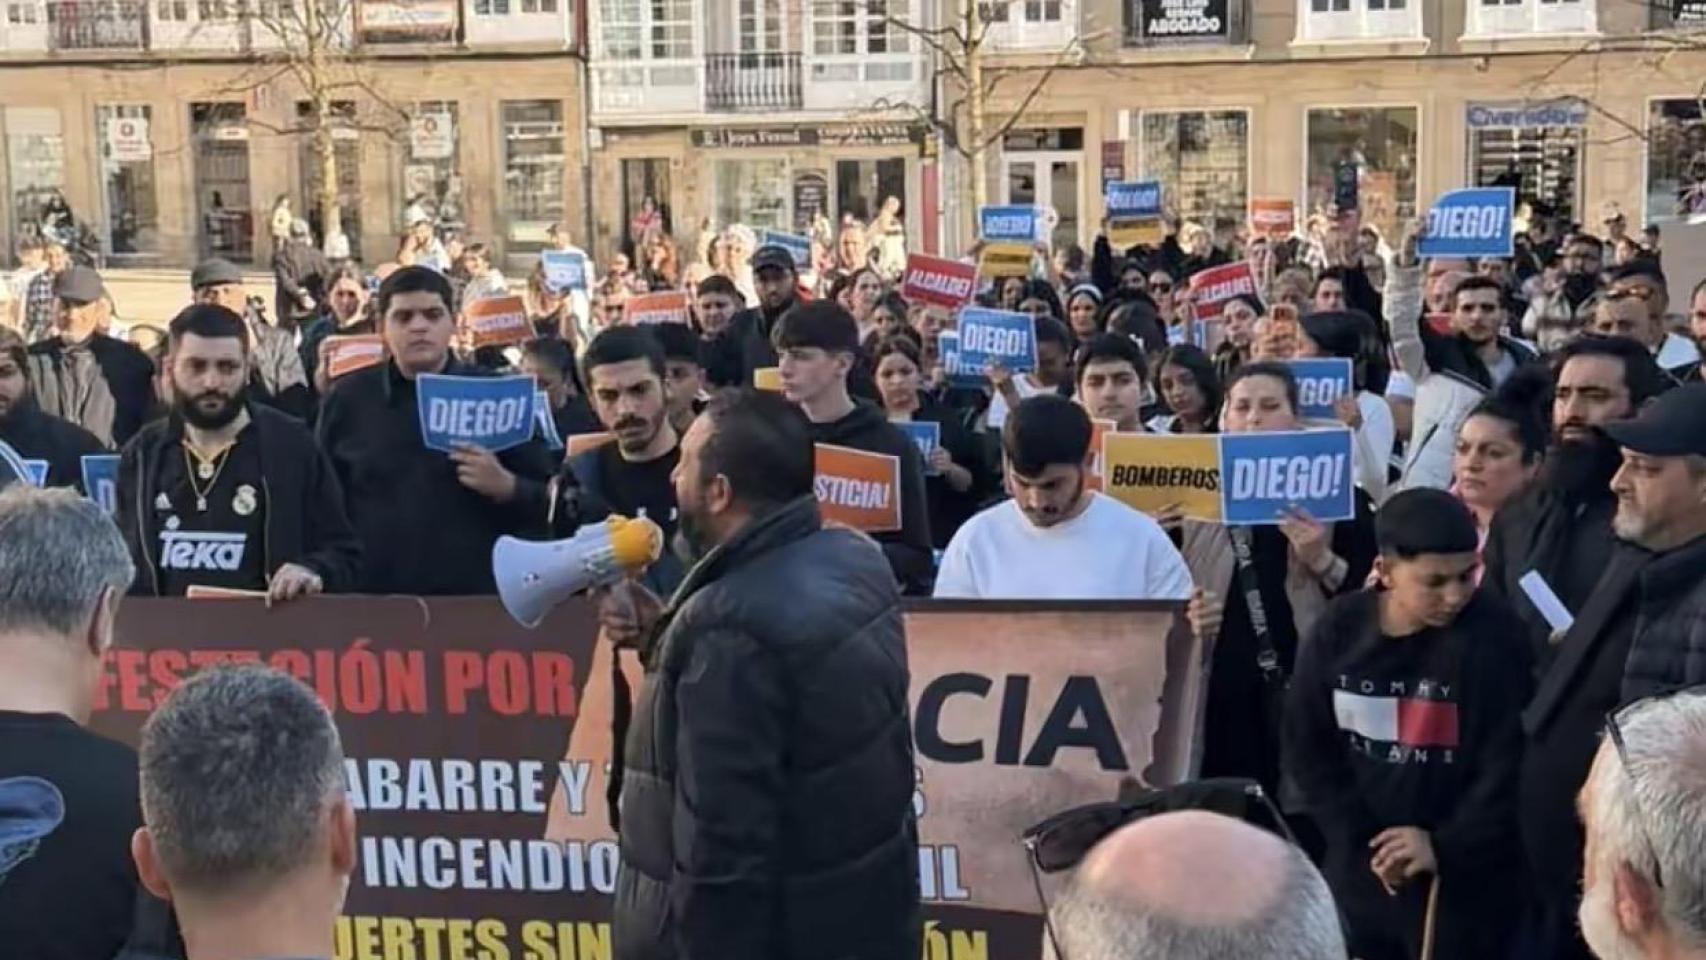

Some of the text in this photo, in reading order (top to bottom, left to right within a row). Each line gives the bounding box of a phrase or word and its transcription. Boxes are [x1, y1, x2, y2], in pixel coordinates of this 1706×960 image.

[1148, 17, 1221, 33] ABOGADO
[1425, 205, 1506, 239] DIEGO!
[963, 323, 1028, 356] DIEGO!
[1299, 377, 1344, 406] GO!
[429, 396, 526, 437] DIEGO!
[814, 474, 890, 509] STICIA!
[1231, 453, 1345, 500] DIEGO!
[444, 651, 577, 718] POR
[1339, 674, 1450, 698] TOMMY
[914, 672, 1129, 771] CIA
[346, 757, 547, 813] ABARRE
[559, 760, 591, 814] Y
[333, 914, 613, 960] UERTES SIN
